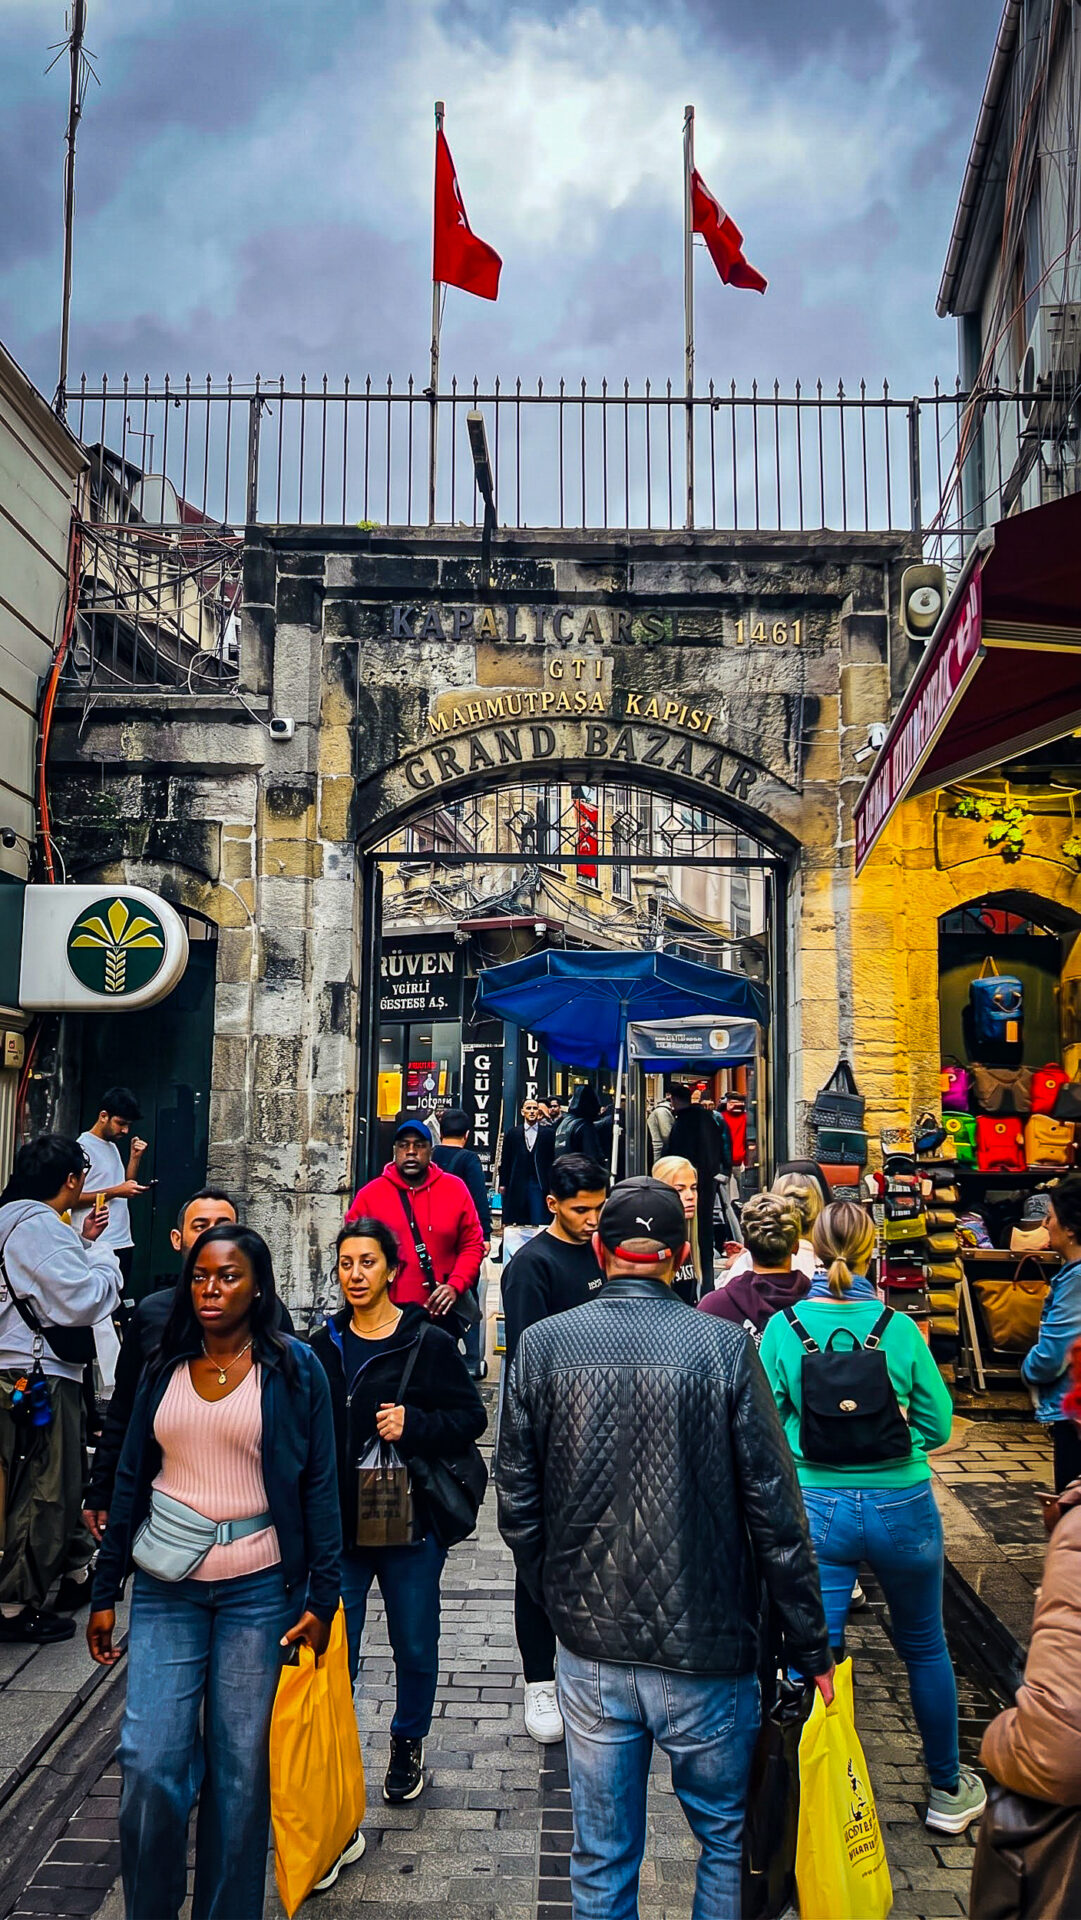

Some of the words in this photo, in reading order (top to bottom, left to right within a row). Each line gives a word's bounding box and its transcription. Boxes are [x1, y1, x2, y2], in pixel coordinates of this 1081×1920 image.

[734, 619, 801, 645] 1461
[427, 691, 606, 736] MAHMUTPAŞA
[625, 693, 716, 735] KAPISI
[405, 725, 556, 790] GRAND
[564, 724, 757, 801] BAZAAR
[474, 1055, 491, 1146] GÜVEN
